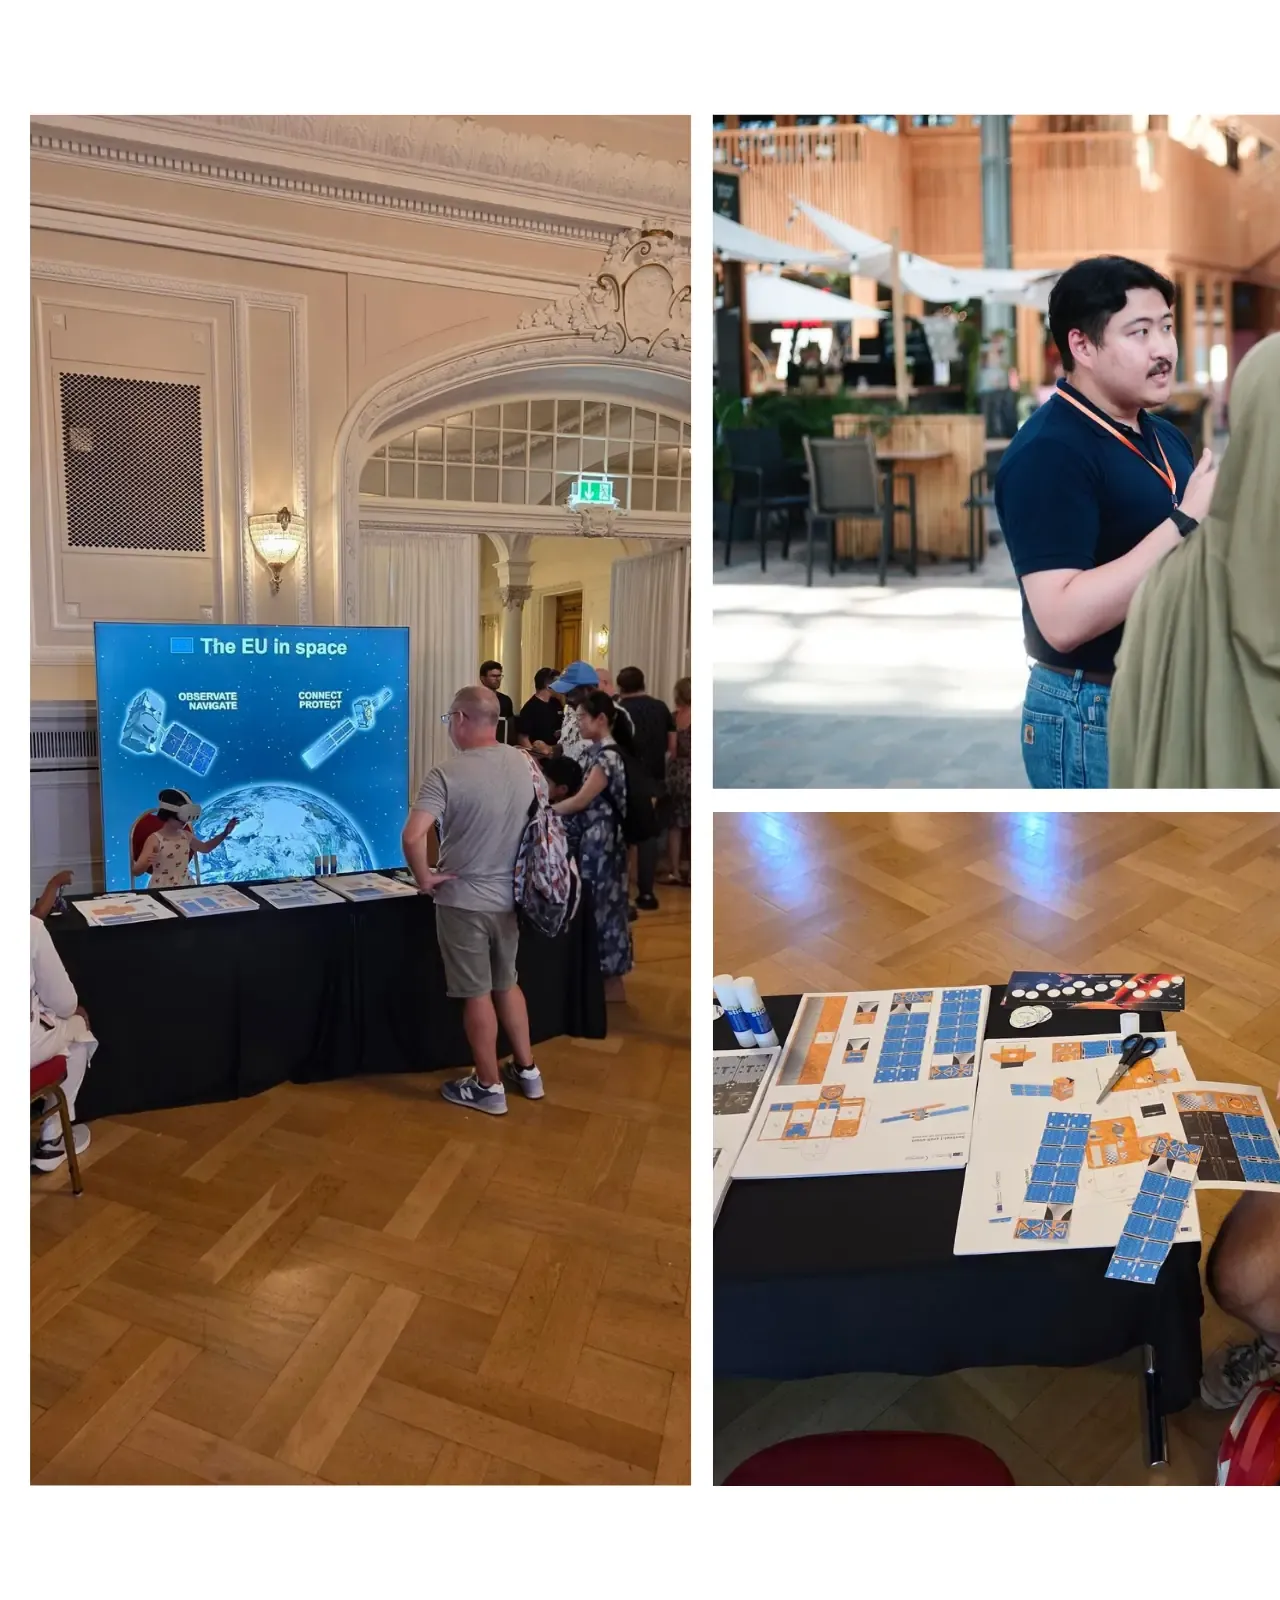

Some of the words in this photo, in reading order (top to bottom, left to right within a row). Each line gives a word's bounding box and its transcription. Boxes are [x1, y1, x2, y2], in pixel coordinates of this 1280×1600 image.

[200, 637, 236, 656] The
[241, 637, 268, 656] EU
[273, 637, 290, 656] in
[295, 641, 348, 659] space
[178, 691, 238, 702] OBSERVATE
[298, 690, 342, 701] CONNECT
[188, 701, 238, 711] NAVIGATE
[299, 700, 342, 710] PROTECT
